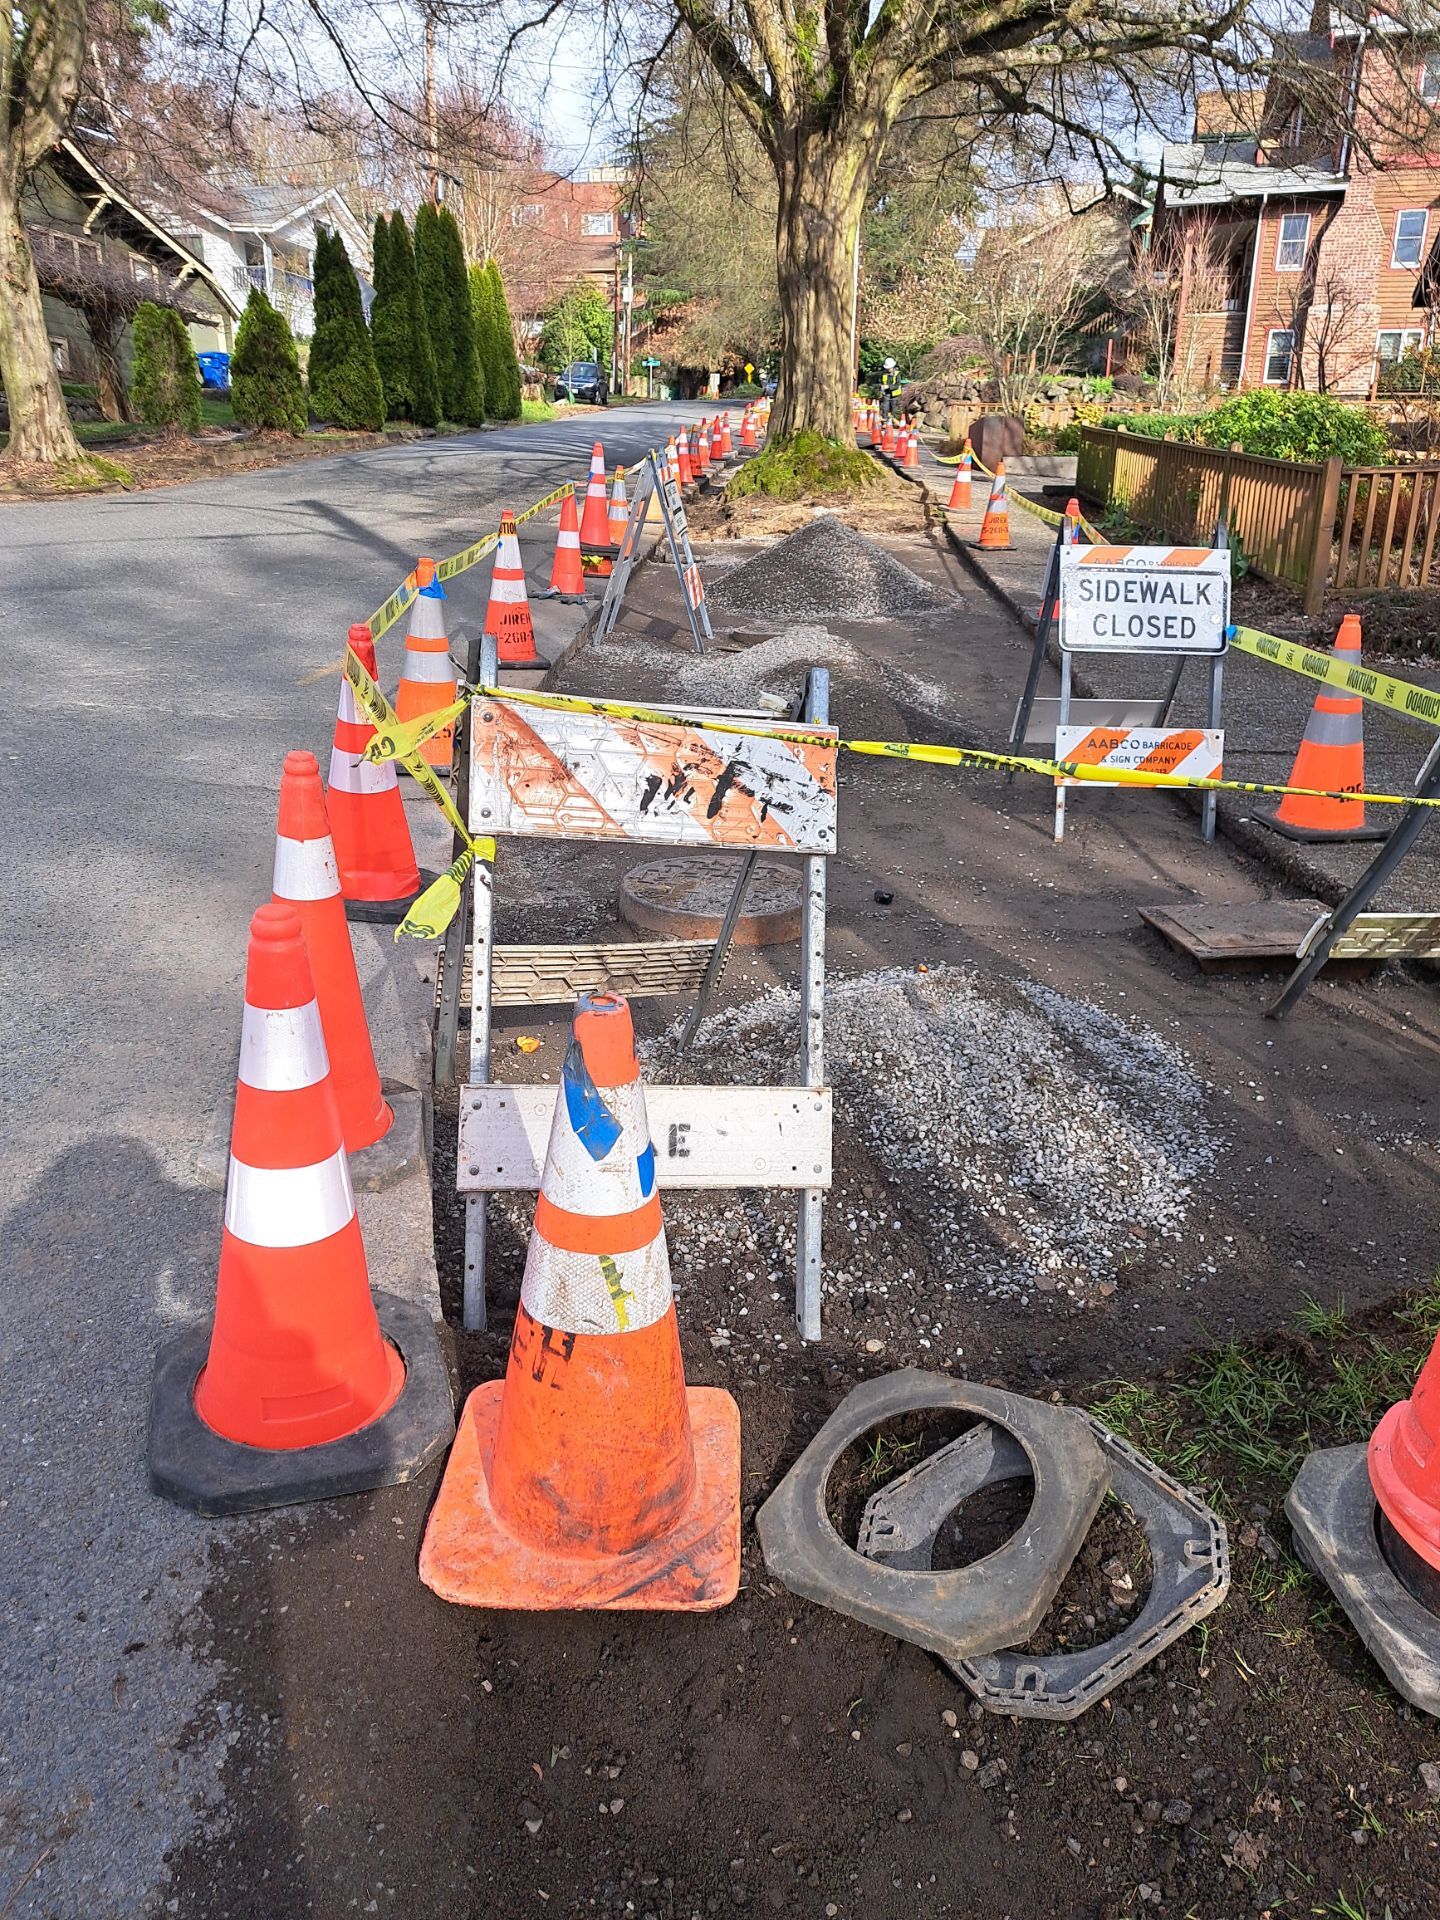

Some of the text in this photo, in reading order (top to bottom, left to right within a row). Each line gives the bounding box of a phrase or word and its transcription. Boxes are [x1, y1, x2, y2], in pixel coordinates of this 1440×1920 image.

[1079, 578, 1212, 606] SIDEWALK
[1092, 613, 1197, 640] CLOSED
[1087, 738, 1192, 750] AABCO BARRICADE
[1100, 755, 1177, 765] & SIGN COMPANY
